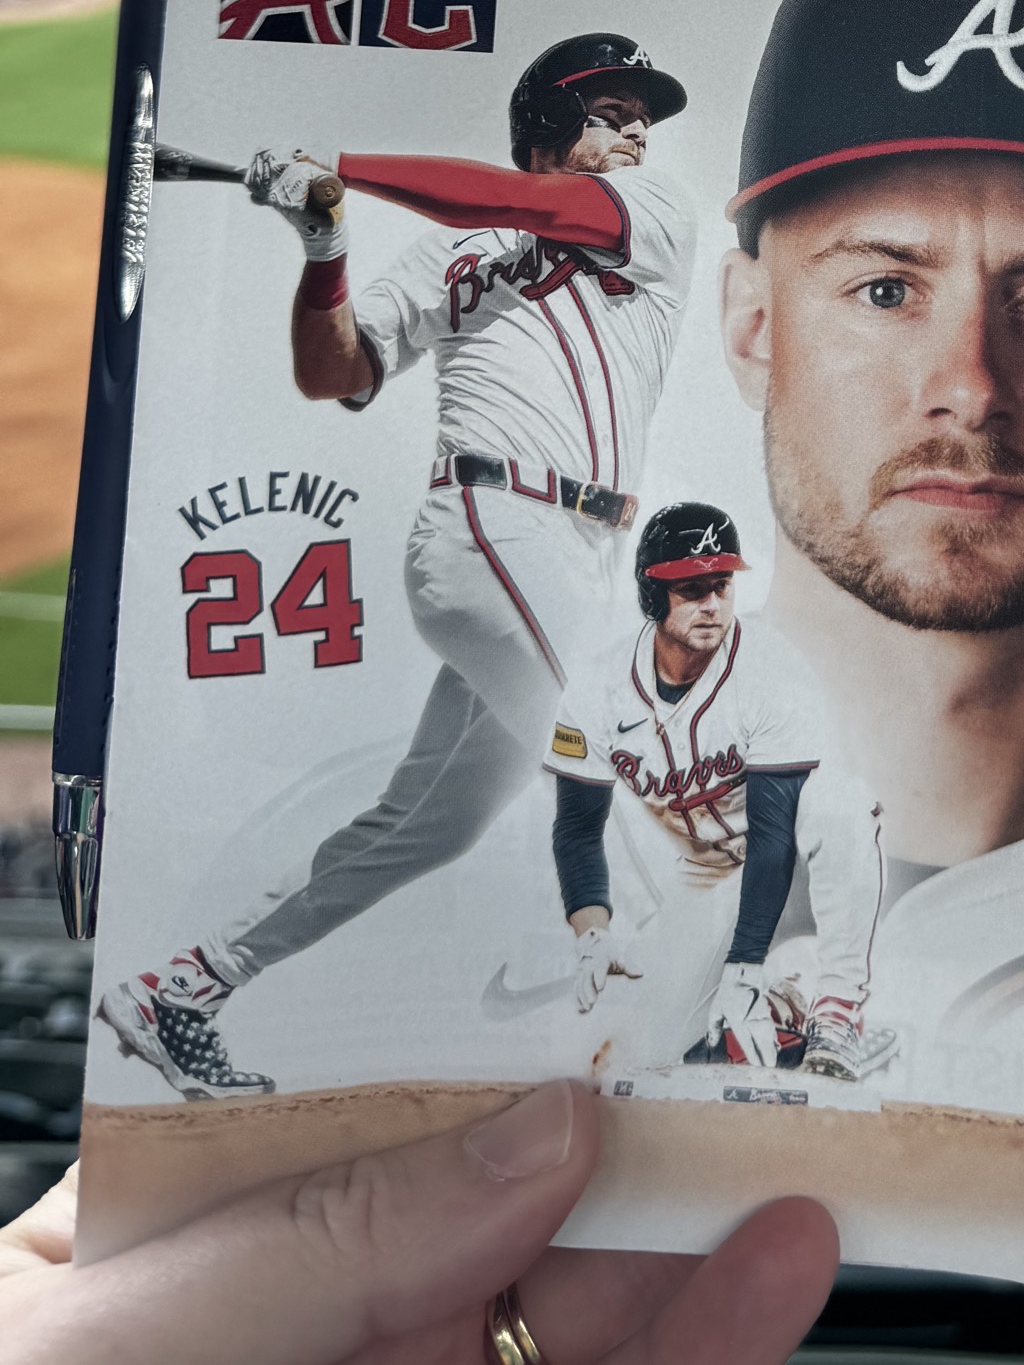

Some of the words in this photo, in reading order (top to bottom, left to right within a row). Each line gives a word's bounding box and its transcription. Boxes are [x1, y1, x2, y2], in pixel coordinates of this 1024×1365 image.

[178, 470, 360, 541] KELENIC
[180, 538, 364, 679] 24
[610, 743, 746, 797] Braves
